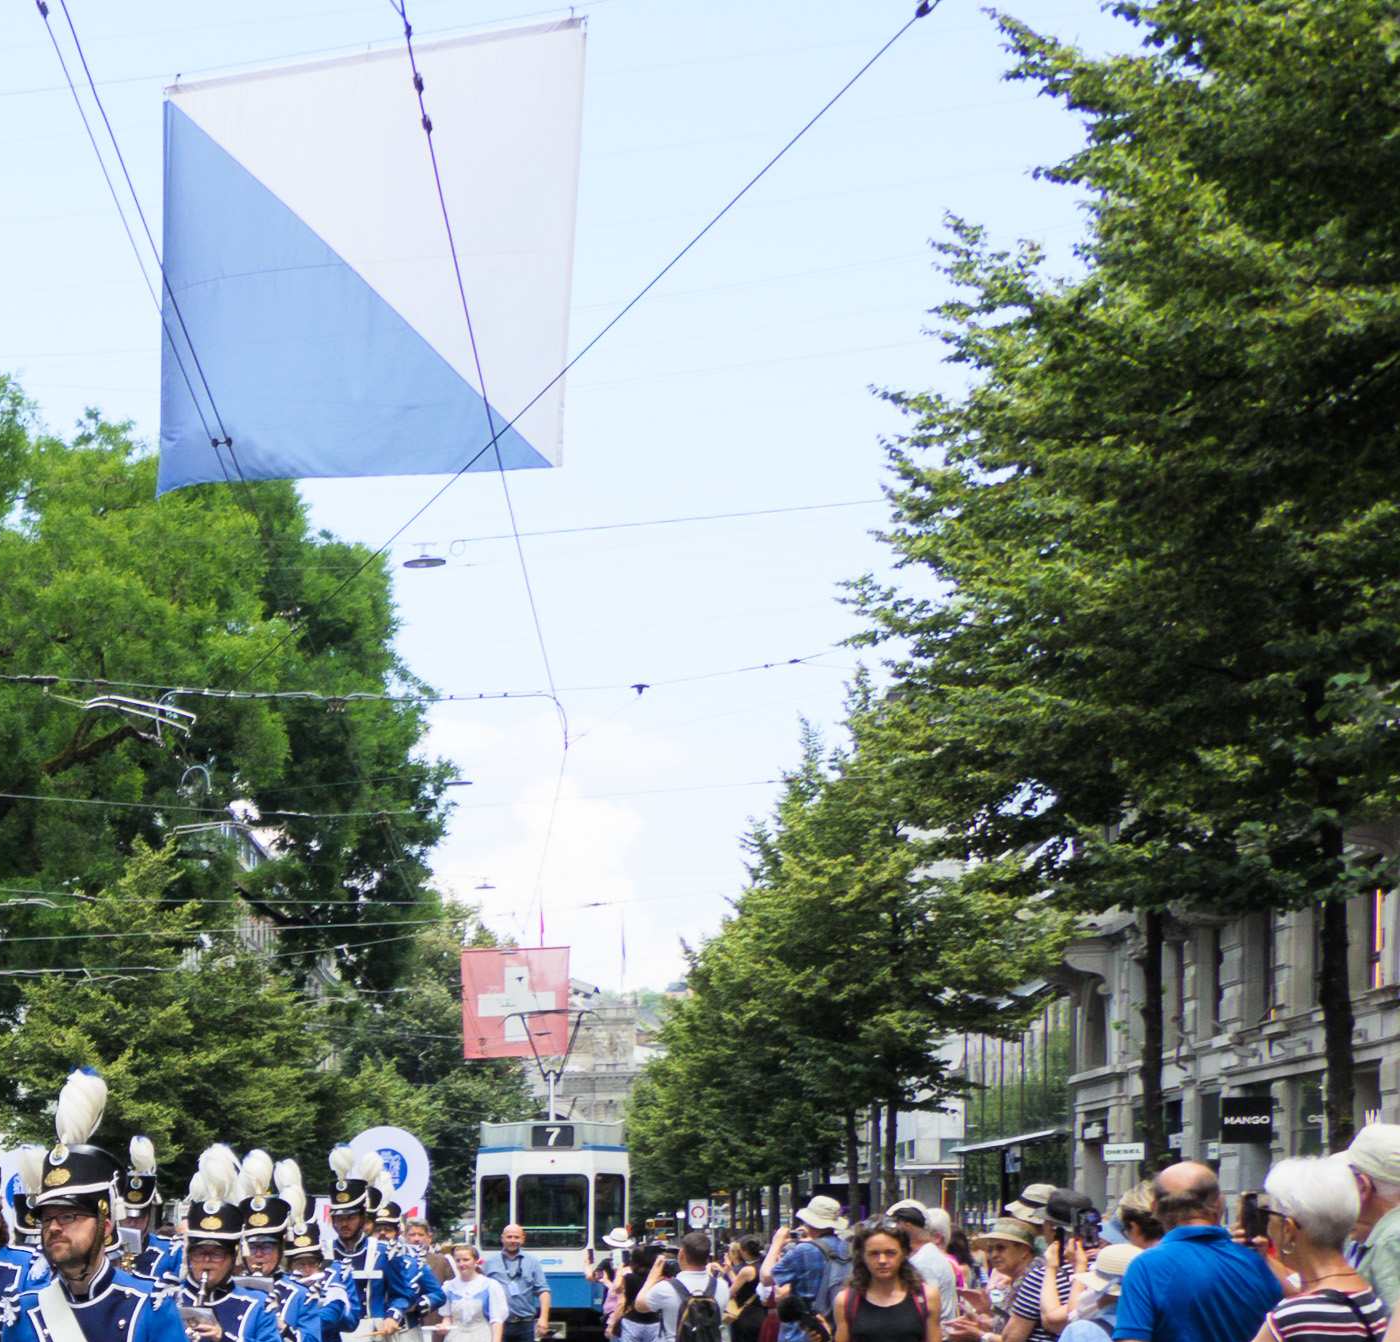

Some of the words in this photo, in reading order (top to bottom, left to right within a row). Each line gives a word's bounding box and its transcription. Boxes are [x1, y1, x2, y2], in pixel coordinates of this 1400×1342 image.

[1223, 1115, 1271, 1125] MANGO
[545, 1127, 561, 1147] 7
[1104, 1148, 1142, 1156] DIESEL
